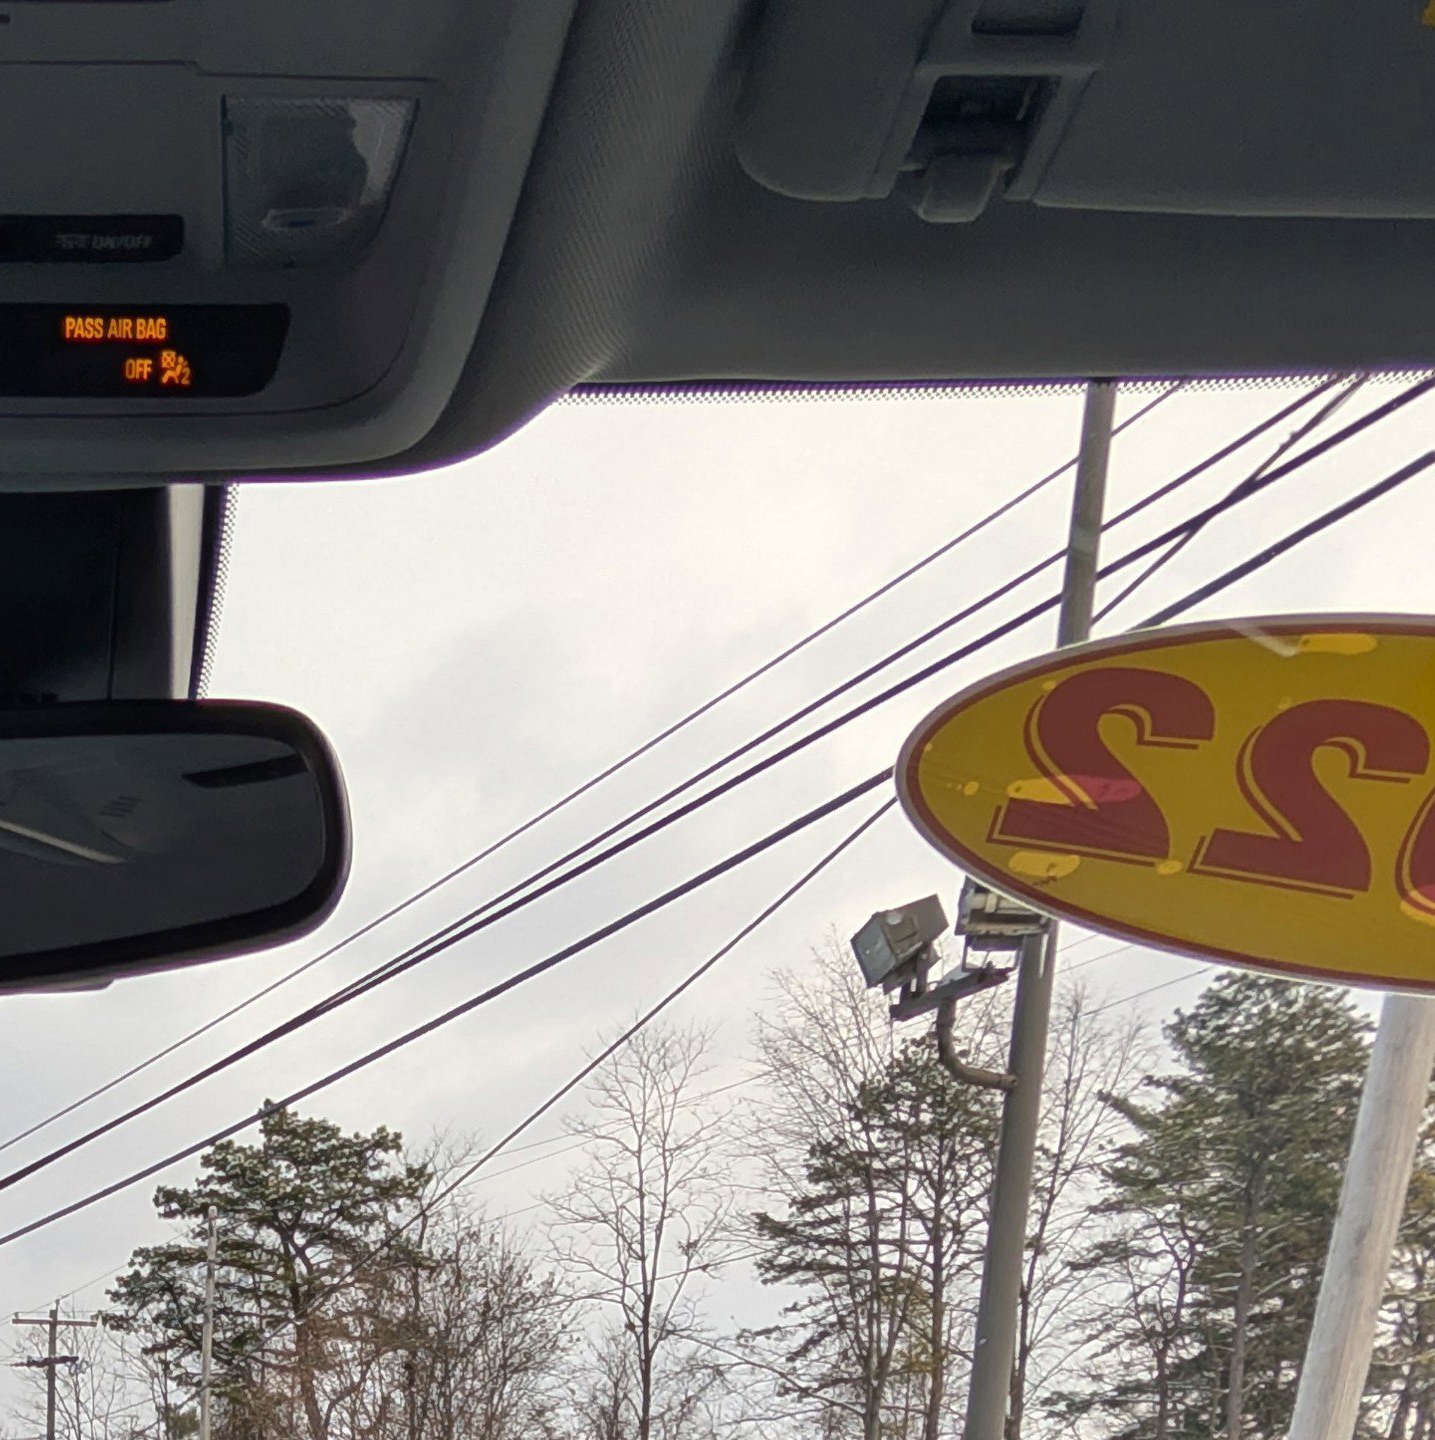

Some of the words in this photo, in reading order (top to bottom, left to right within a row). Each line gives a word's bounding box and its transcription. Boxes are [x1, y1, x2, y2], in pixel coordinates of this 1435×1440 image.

[64, 316, 105, 341] PASS
[108, 317, 134, 341] AIR
[136, 317, 167, 342] BAG
[124, 357, 153, 382] OFF
